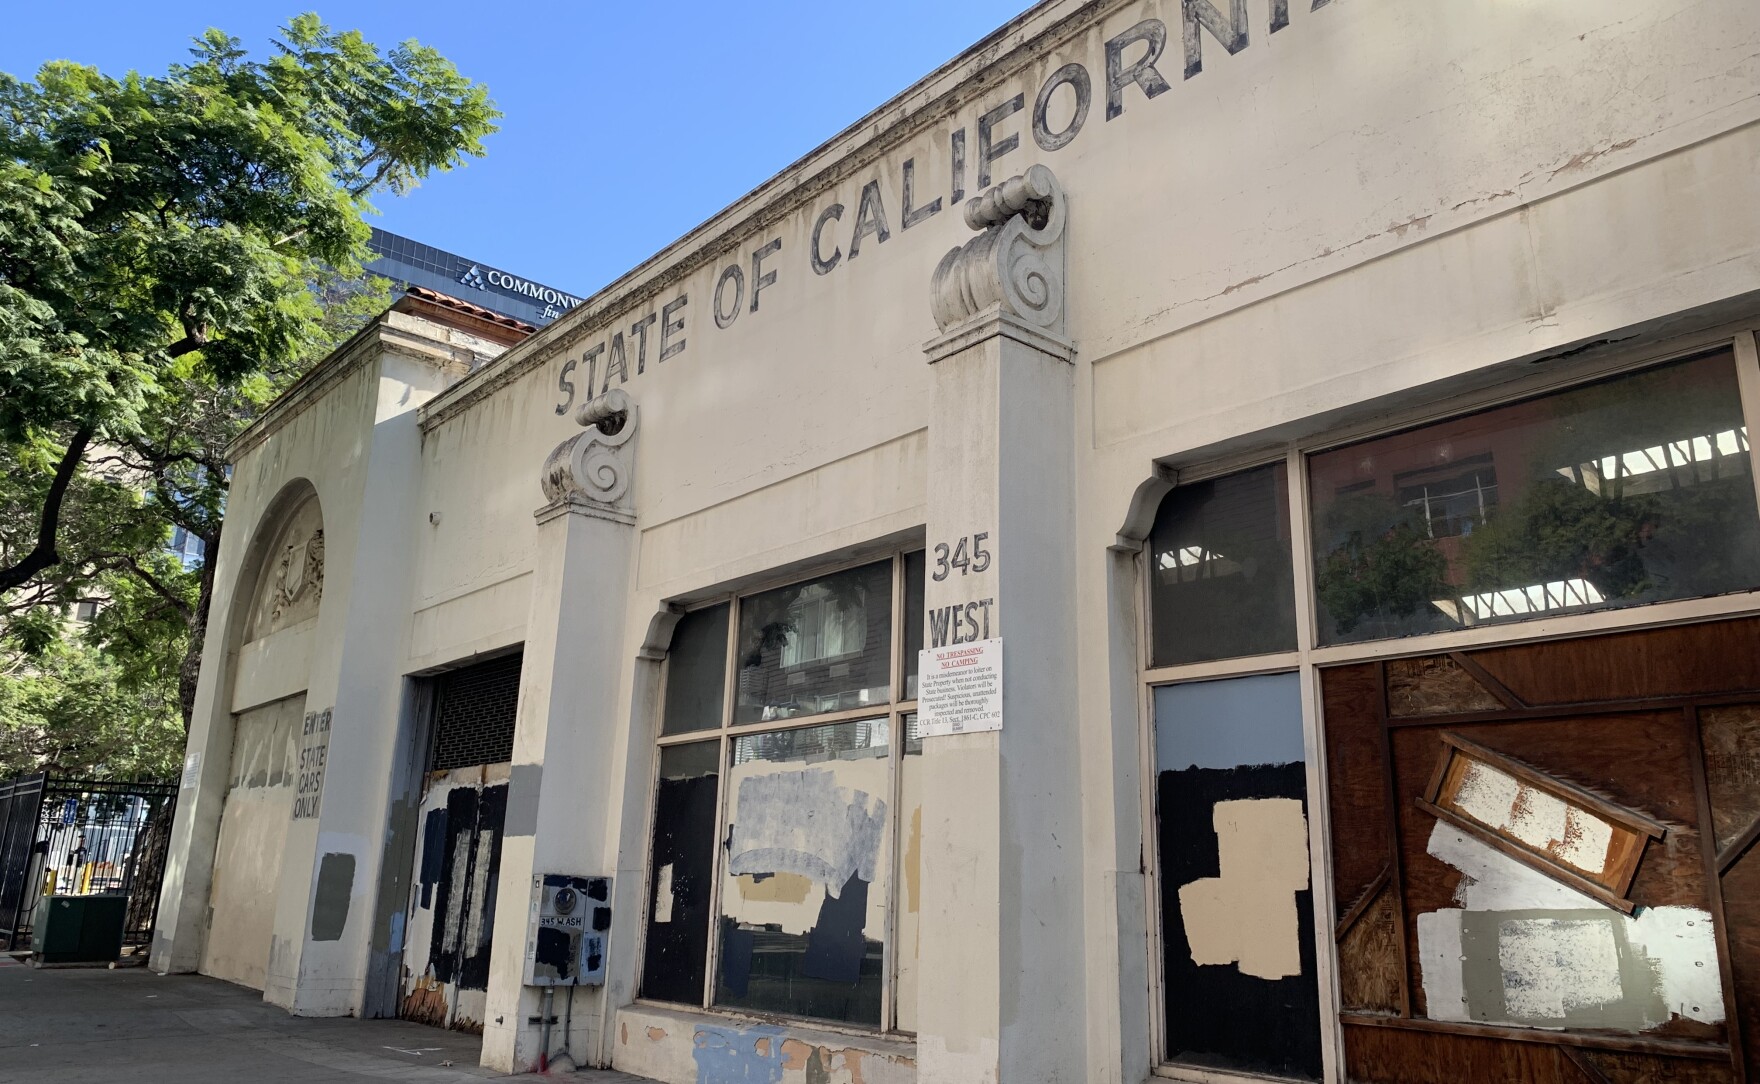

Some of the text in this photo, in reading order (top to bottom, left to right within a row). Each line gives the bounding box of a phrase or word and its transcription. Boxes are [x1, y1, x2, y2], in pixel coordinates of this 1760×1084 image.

[555, 0, 1328, 416] STATE OF CALIFORN
[540, 304, 562, 319] fin
[932, 531, 991, 582] 345
[929, 597, 993, 649] WEST
[947, 646, 984, 659] TRESPASSING
[951, 657, 978, 667] CAMPING
[933, 679, 951, 688] Property
[972, 673, 998, 682] conducting
[929, 702, 948, 711] packages
[965, 697, 989, 706] thoroughly
[304, 711, 332, 736] ENTER
[919, 718, 931, 726] CCR
[979, 712, 991, 720] CPC
[300, 745, 326, 770] STATE
[298, 771, 321, 794] CARS
[294, 797, 318, 818] ONLY
[541, 917, 555, 926] 345
